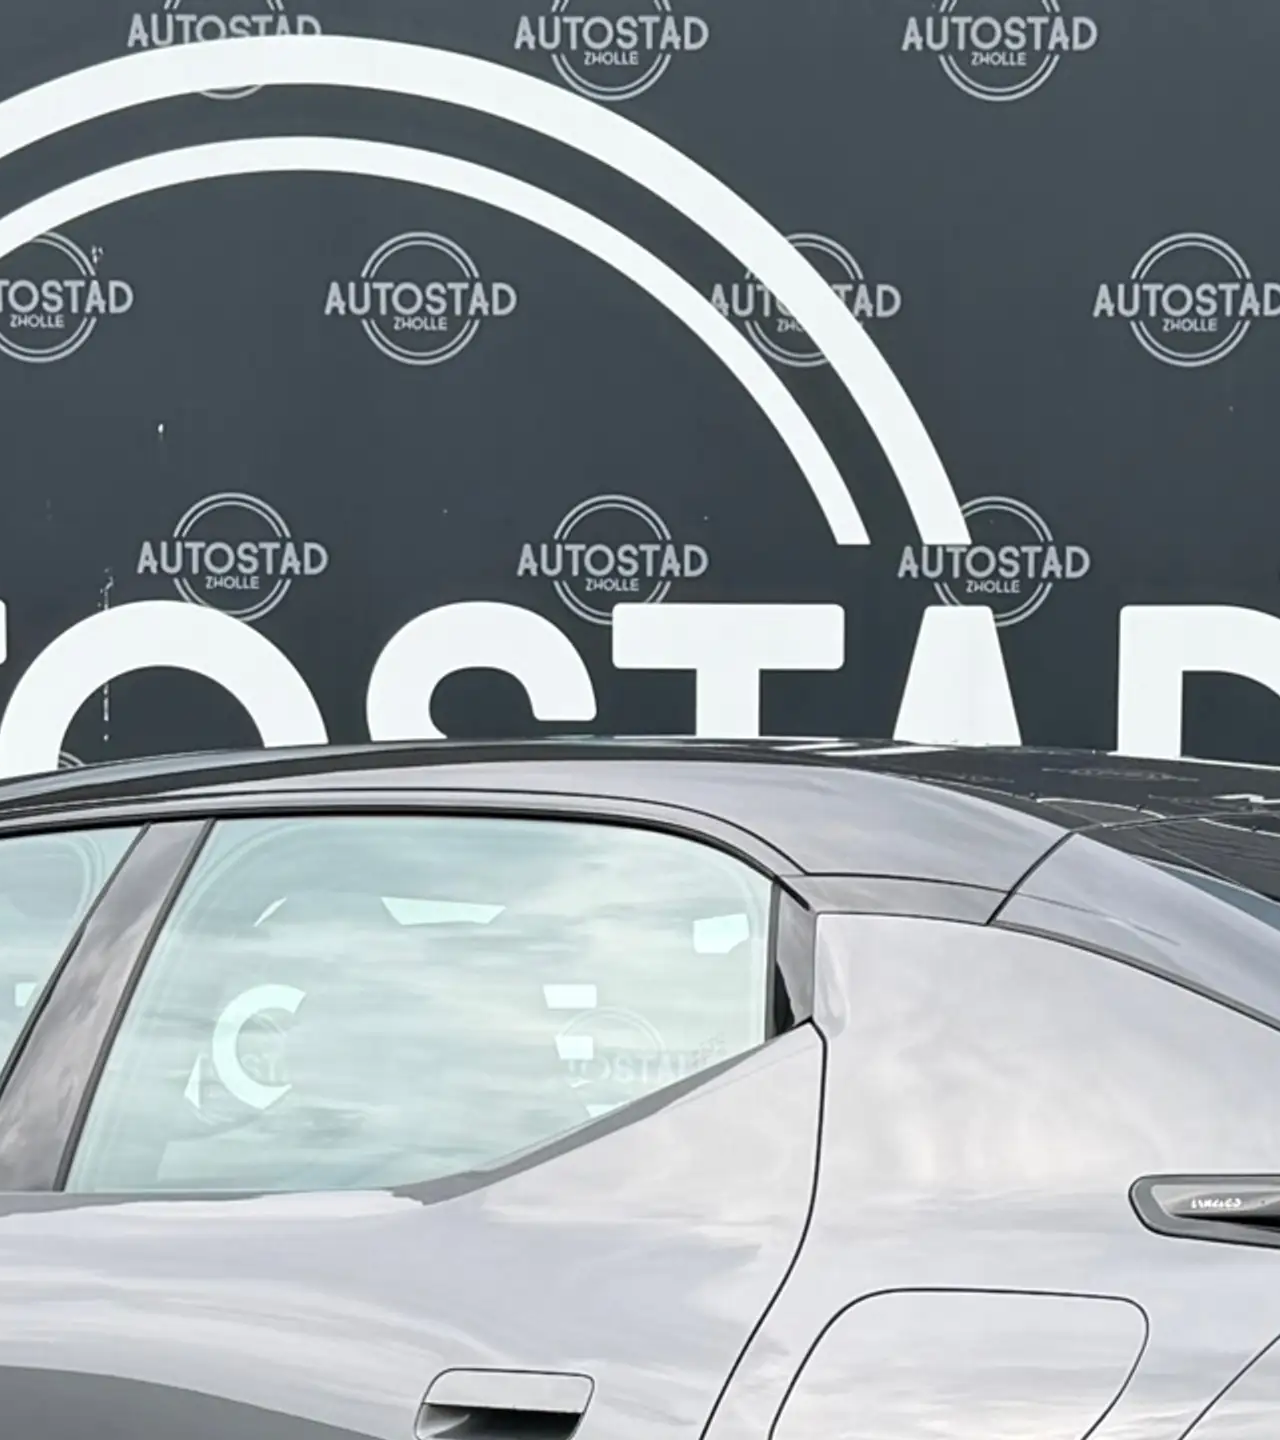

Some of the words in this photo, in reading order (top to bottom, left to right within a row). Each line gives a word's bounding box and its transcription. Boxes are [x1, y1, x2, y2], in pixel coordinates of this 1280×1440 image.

[127, 13, 321, 47] AUTOSTAD
[514, 16, 709, 50] AUTOSTAD
[902, 16, 1097, 51] AUTOSTAD
[324, 281, 517, 316] AUTOSTAD
[711, 283, 901, 318] AUTTAD
[137, 541, 328, 575] AUTOSTAD
[517, 543, 708, 577] AUTOSTAD
[898, 545, 1090, 578] AUTOSTAD
